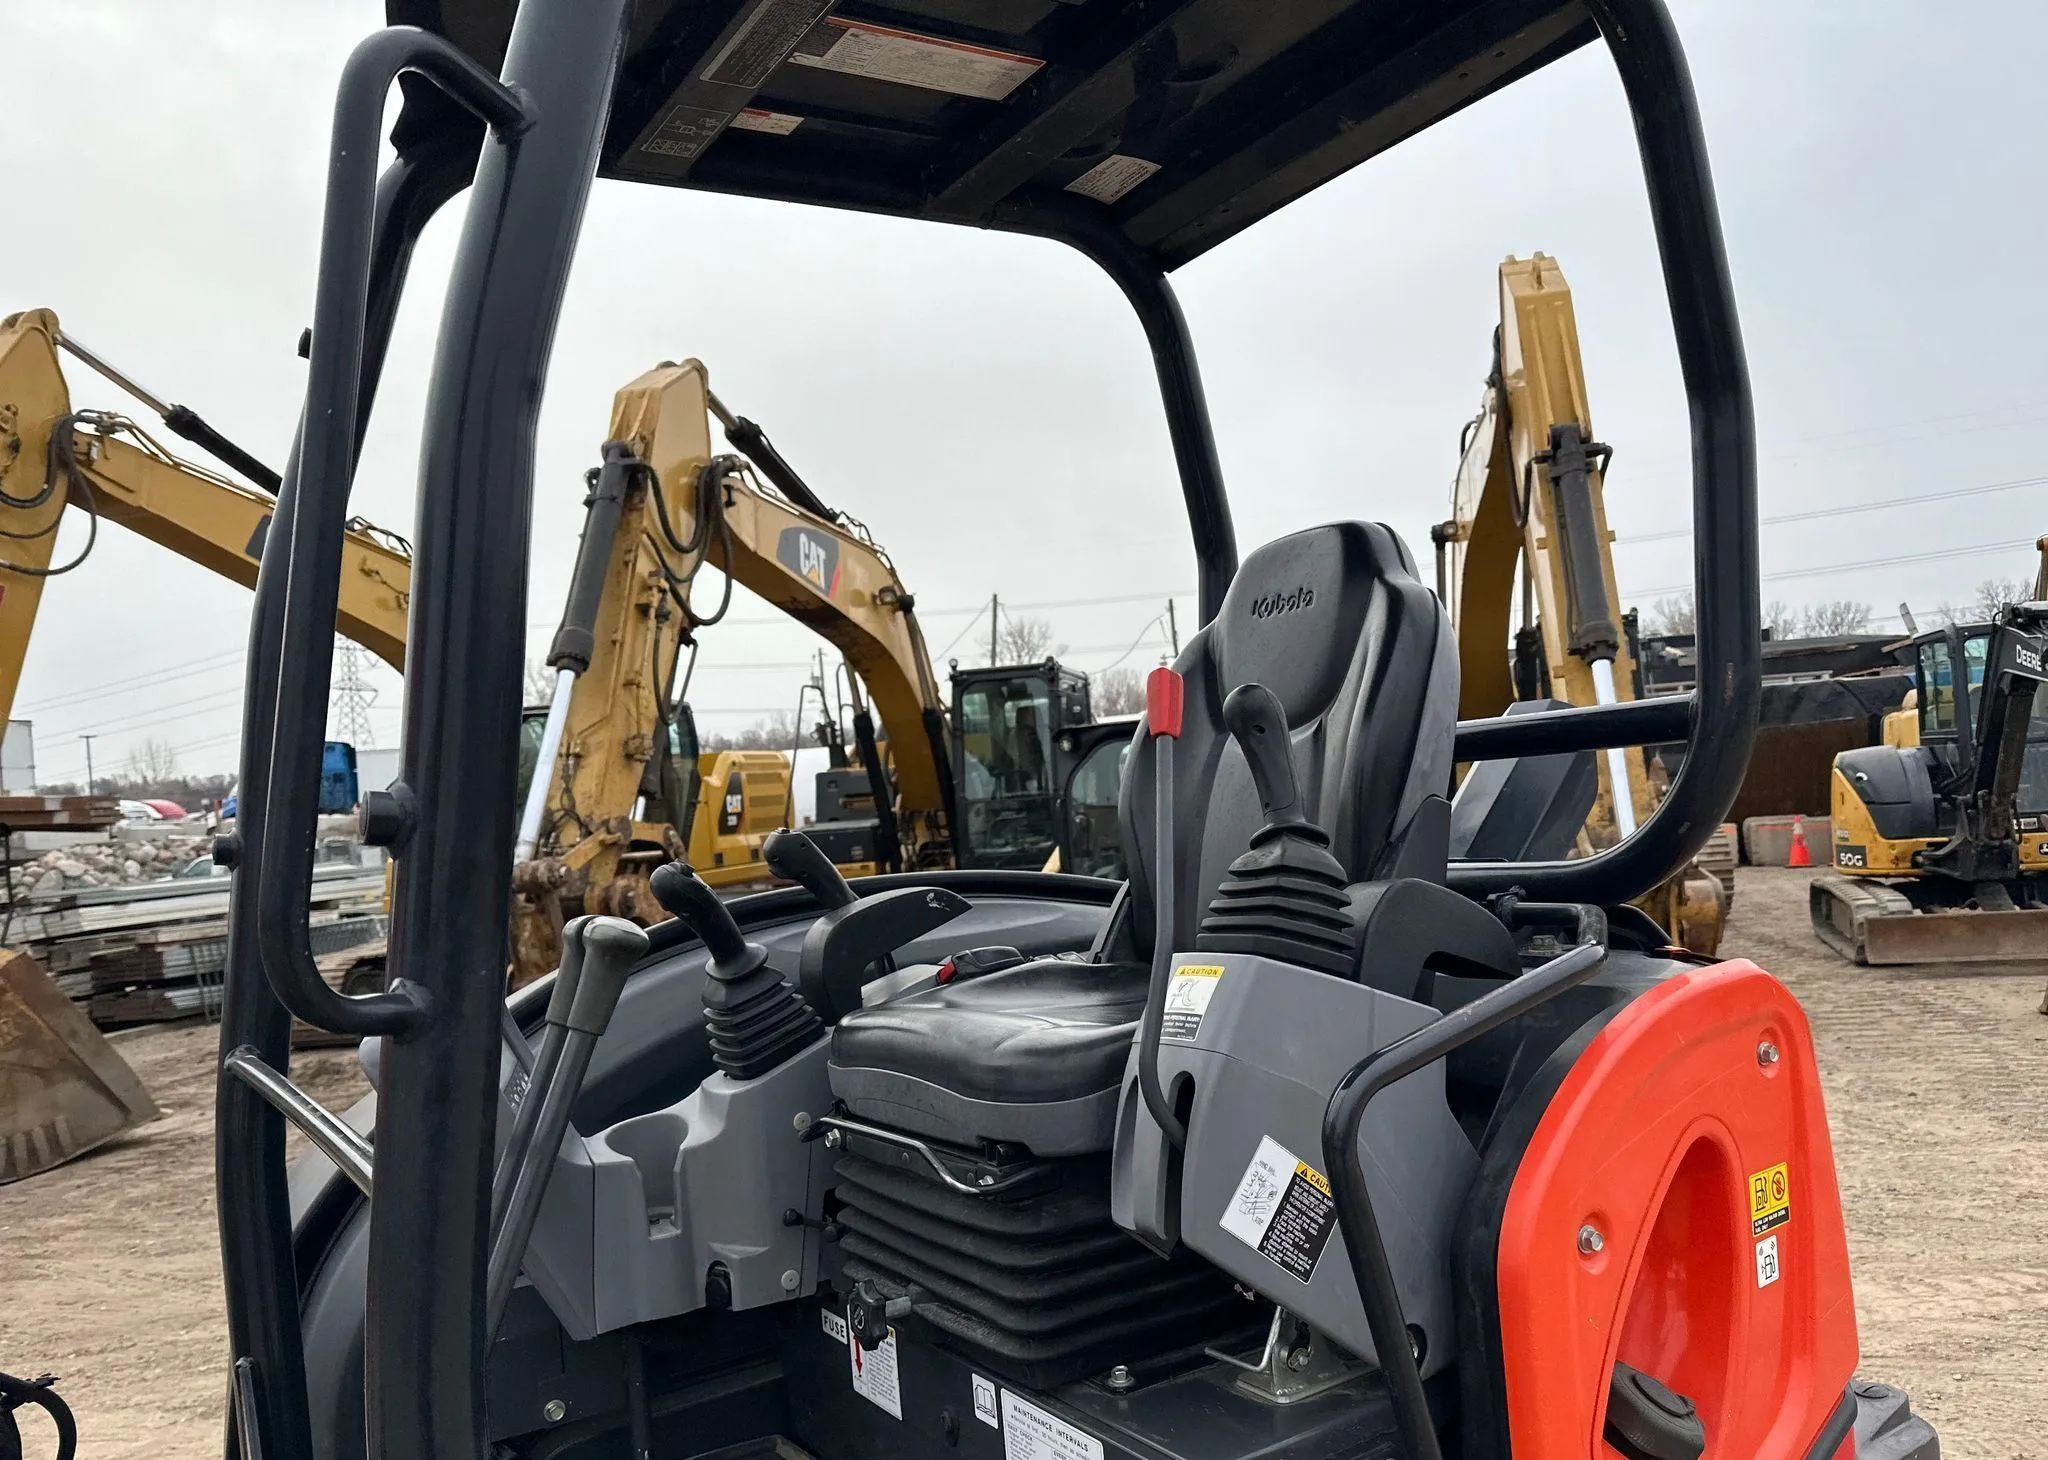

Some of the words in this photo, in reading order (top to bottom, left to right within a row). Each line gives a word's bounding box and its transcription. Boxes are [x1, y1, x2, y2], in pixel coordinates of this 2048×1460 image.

[799, 532, 826, 589] CAT
[1252, 587, 1314, 619] Kubota
[2016, 644, 2042, 672] DEERE
[726, 794, 742, 813] CAT
[1840, 852, 1863, 867] 50G
[1186, 968, 1219, 976] CAUTION
[823, 1315, 845, 1338] FUSE
[1013, 1405, 1053, 1432] MAINTENANCE
[1056, 1428, 1089, 1452] INTERVALS
[1020, 1430, 1033, 1441] CHECK
